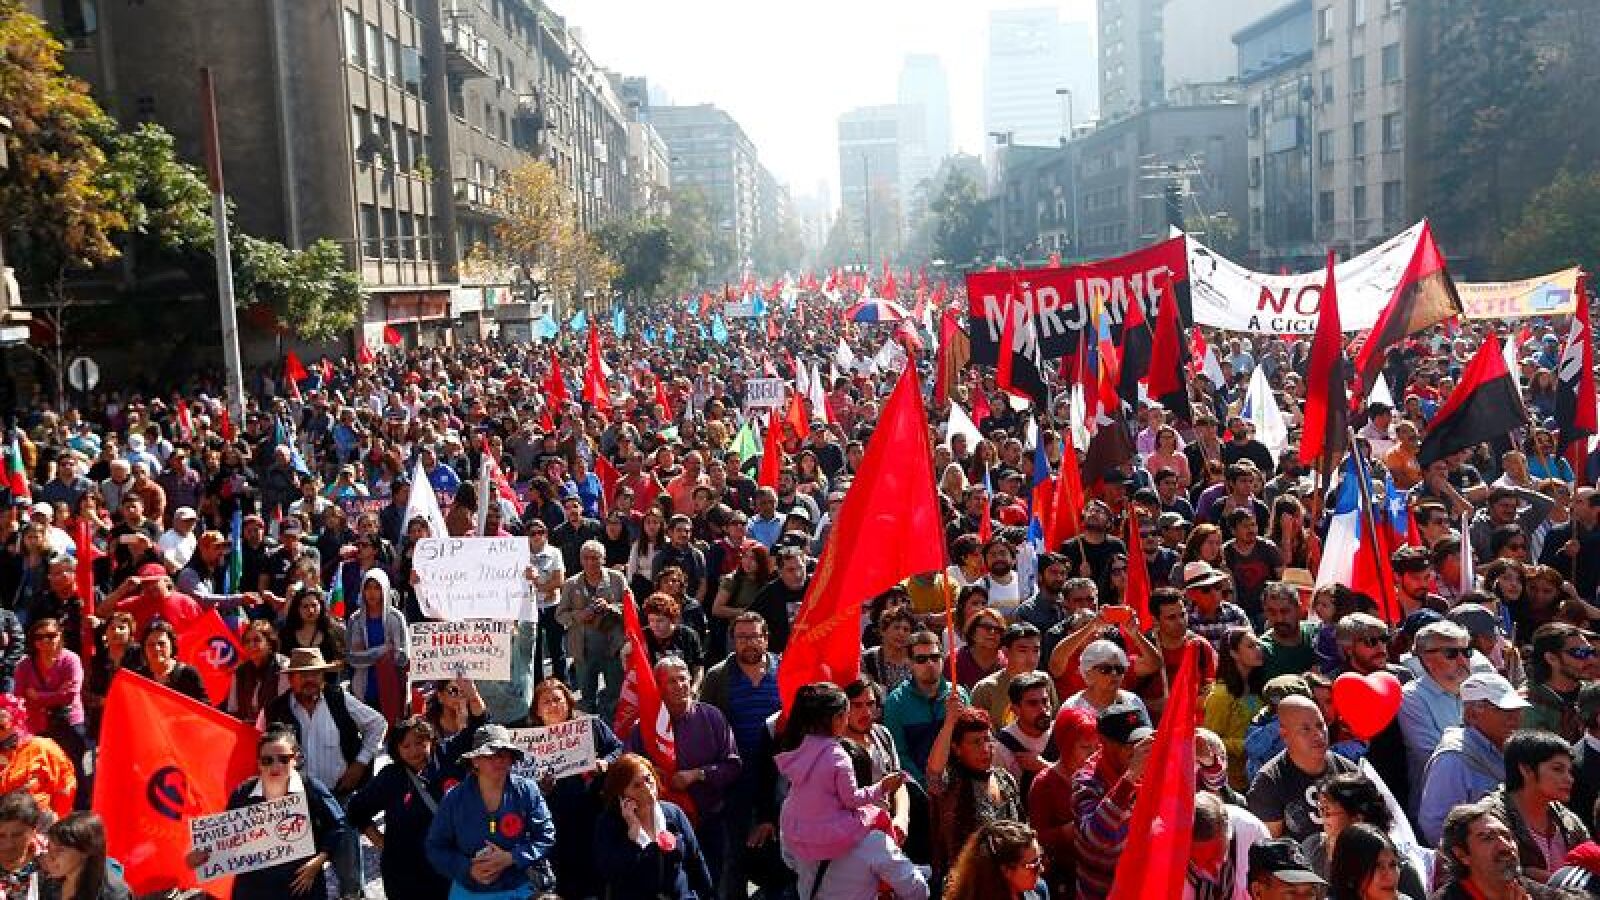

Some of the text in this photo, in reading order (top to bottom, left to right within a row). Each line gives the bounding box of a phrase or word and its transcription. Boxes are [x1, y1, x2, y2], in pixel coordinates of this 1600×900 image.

[1256, 284, 1323, 315] NO
[1466, 296, 1521, 314] XTIL
[1248, 315, 1260, 330] A
[421, 539, 463, 560] SIP
[413, 622, 470, 635] ESCUELA
[432, 633, 493, 647] HUELGA
[529, 737, 581, 755] HUELGA
[192, 811, 242, 831] ESCUELA
[193, 826, 230, 845] MATTE
[215, 828, 269, 851] HUELGA
[203, 843, 295, 878] LA BANDERA
